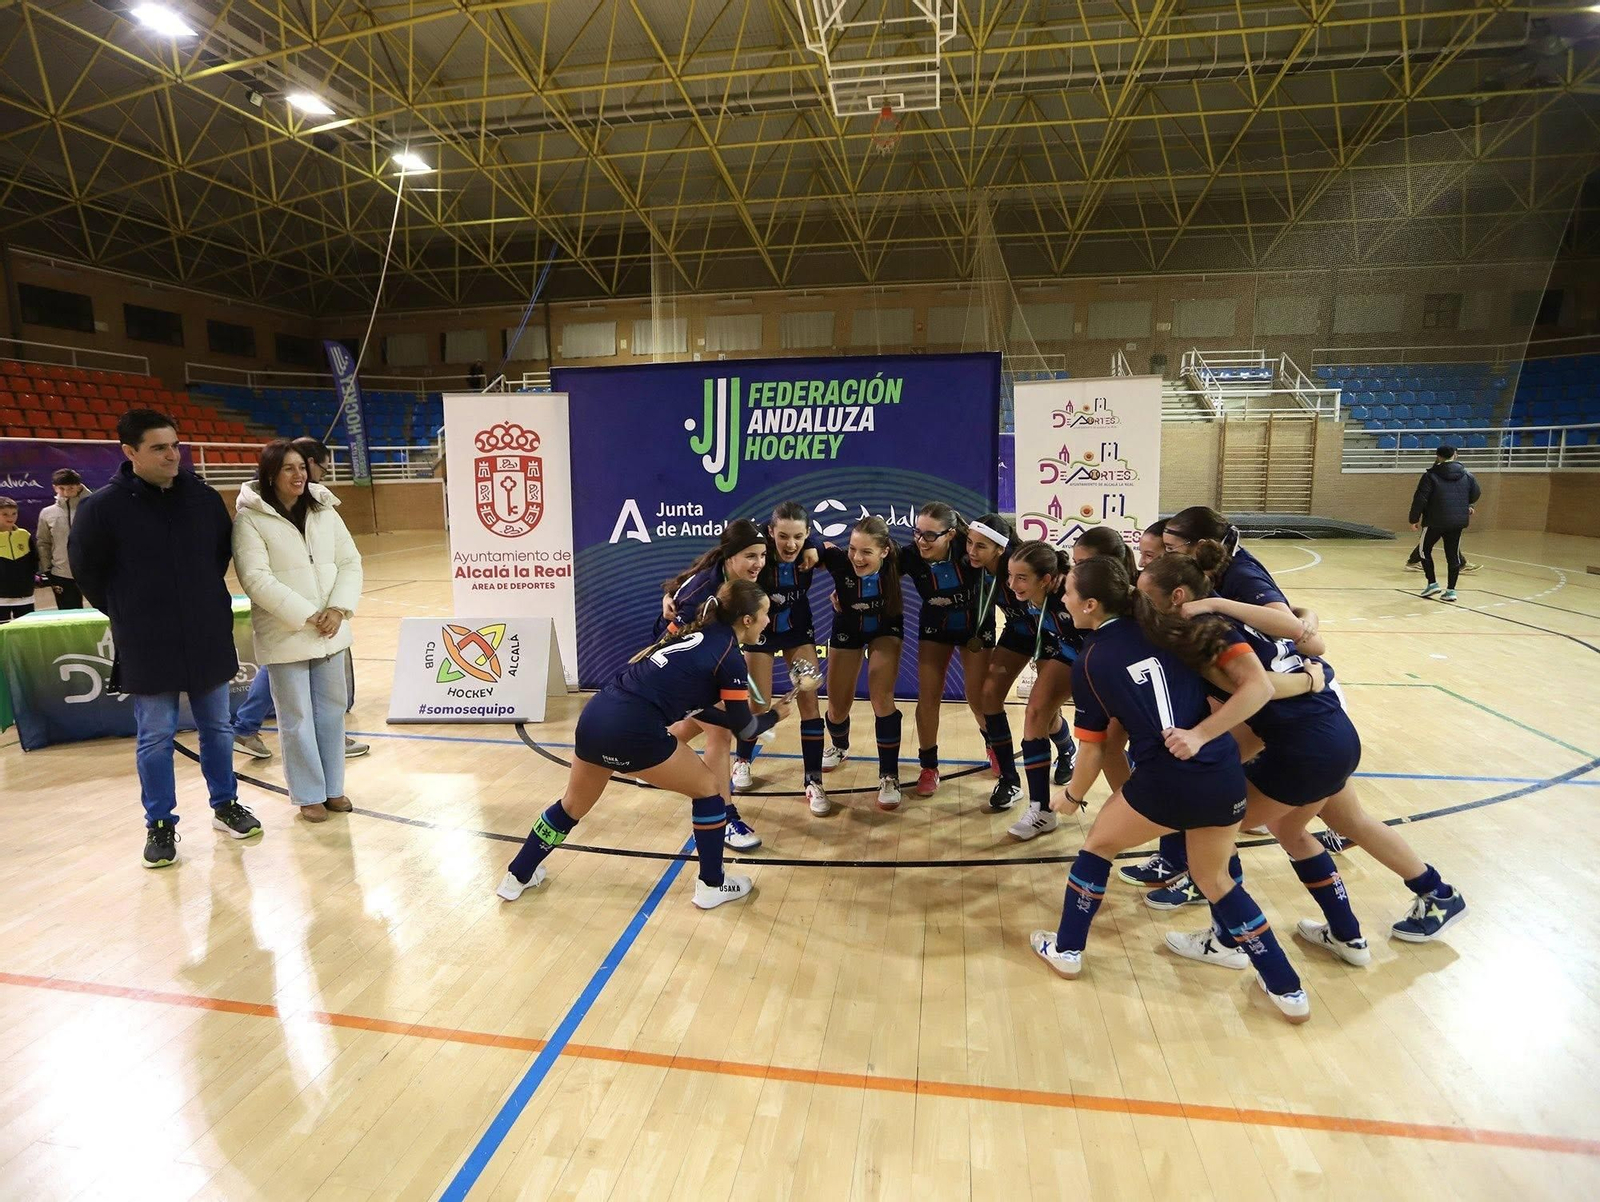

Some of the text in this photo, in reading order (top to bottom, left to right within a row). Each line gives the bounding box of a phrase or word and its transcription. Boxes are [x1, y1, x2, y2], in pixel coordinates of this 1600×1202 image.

[748, 371, 904, 408] FEDERACIÓN
[747, 406, 875, 434] ANDALUZA
[744, 433, 845, 461] HOCKEY
[656, 502, 704, 517] Junta
[656, 521, 677, 537] de
[453, 550, 572, 565] Ayuntamiento de
[455, 564, 572, 579] Alcalá la Real
[497, 582, 508, 590] DE
[510, 582, 556, 590] DEPORTES
[425, 641, 436, 669] CLUB
[508, 634, 520, 677] ALCALÁ
[447, 687, 494, 699] HOCKEY
[1126, 656, 1176, 731] 7
[418, 703, 515, 717] #somosequipo
[719, 885, 741, 893] OSAKA
